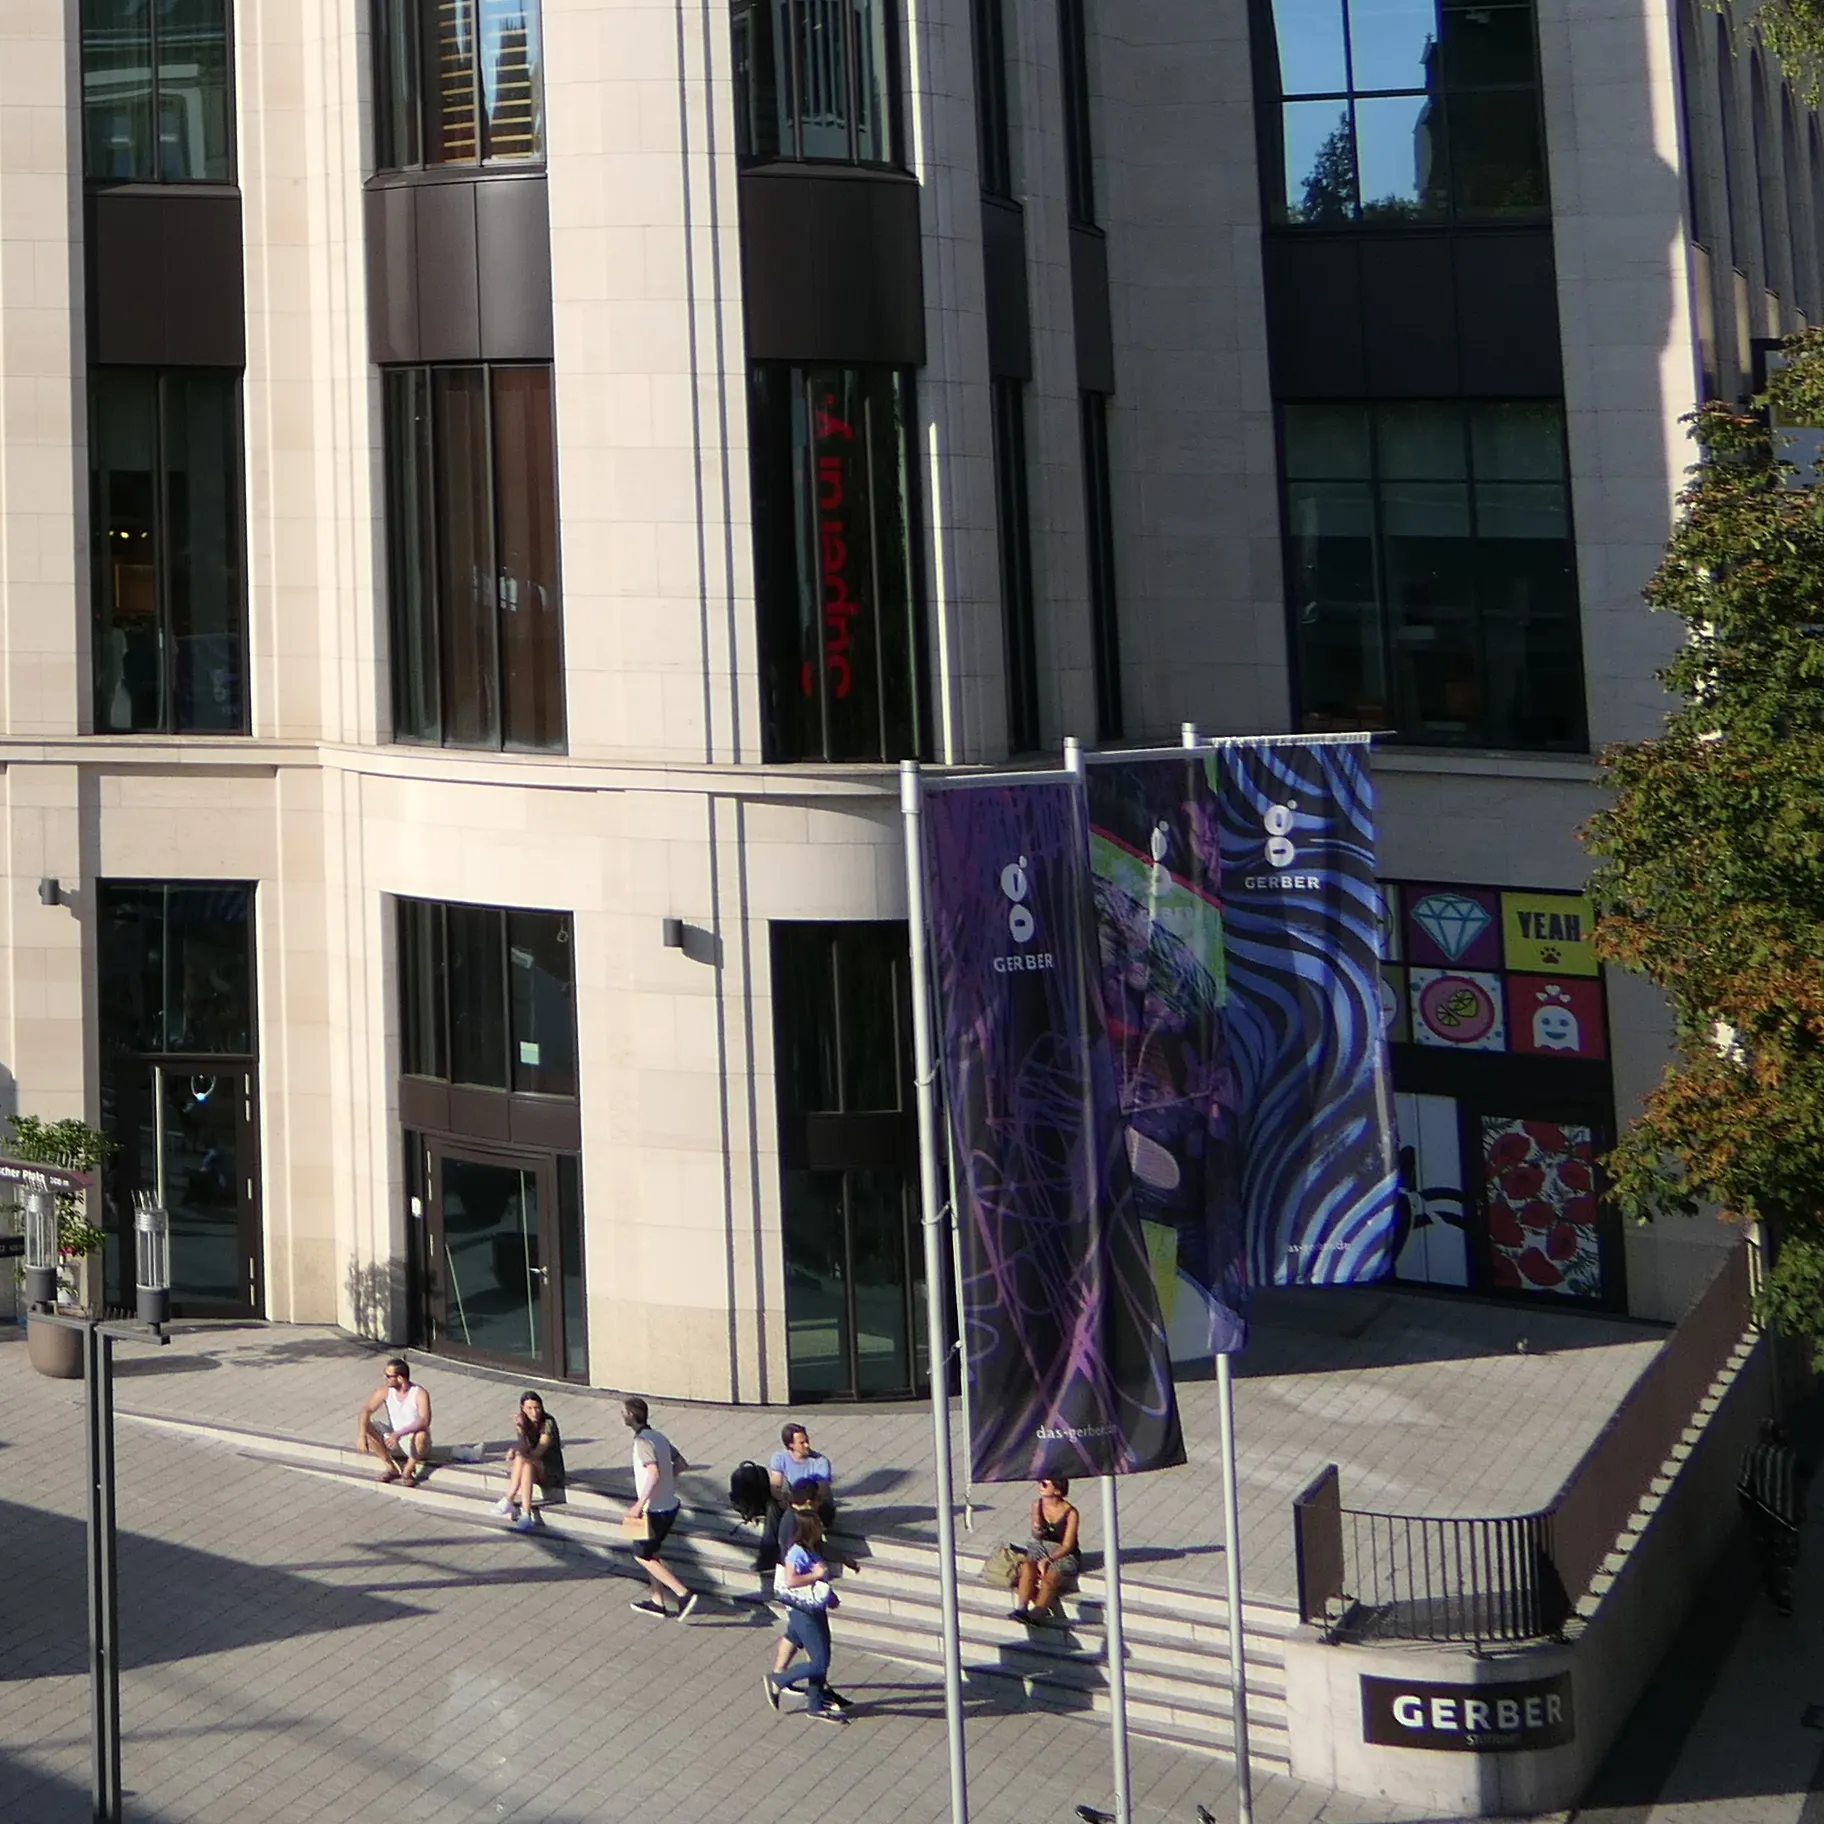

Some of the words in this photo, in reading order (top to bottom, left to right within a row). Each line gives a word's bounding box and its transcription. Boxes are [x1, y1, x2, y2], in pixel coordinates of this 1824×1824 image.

[1244, 875, 1320, 890] GERBER
[1517, 909, 1582, 943] YEAH
[993, 952, 1055, 974] GERBER
[1036, 1423, 1118, 1444] das-gerber.d
[1392, 1693, 1564, 1731] GERBER
